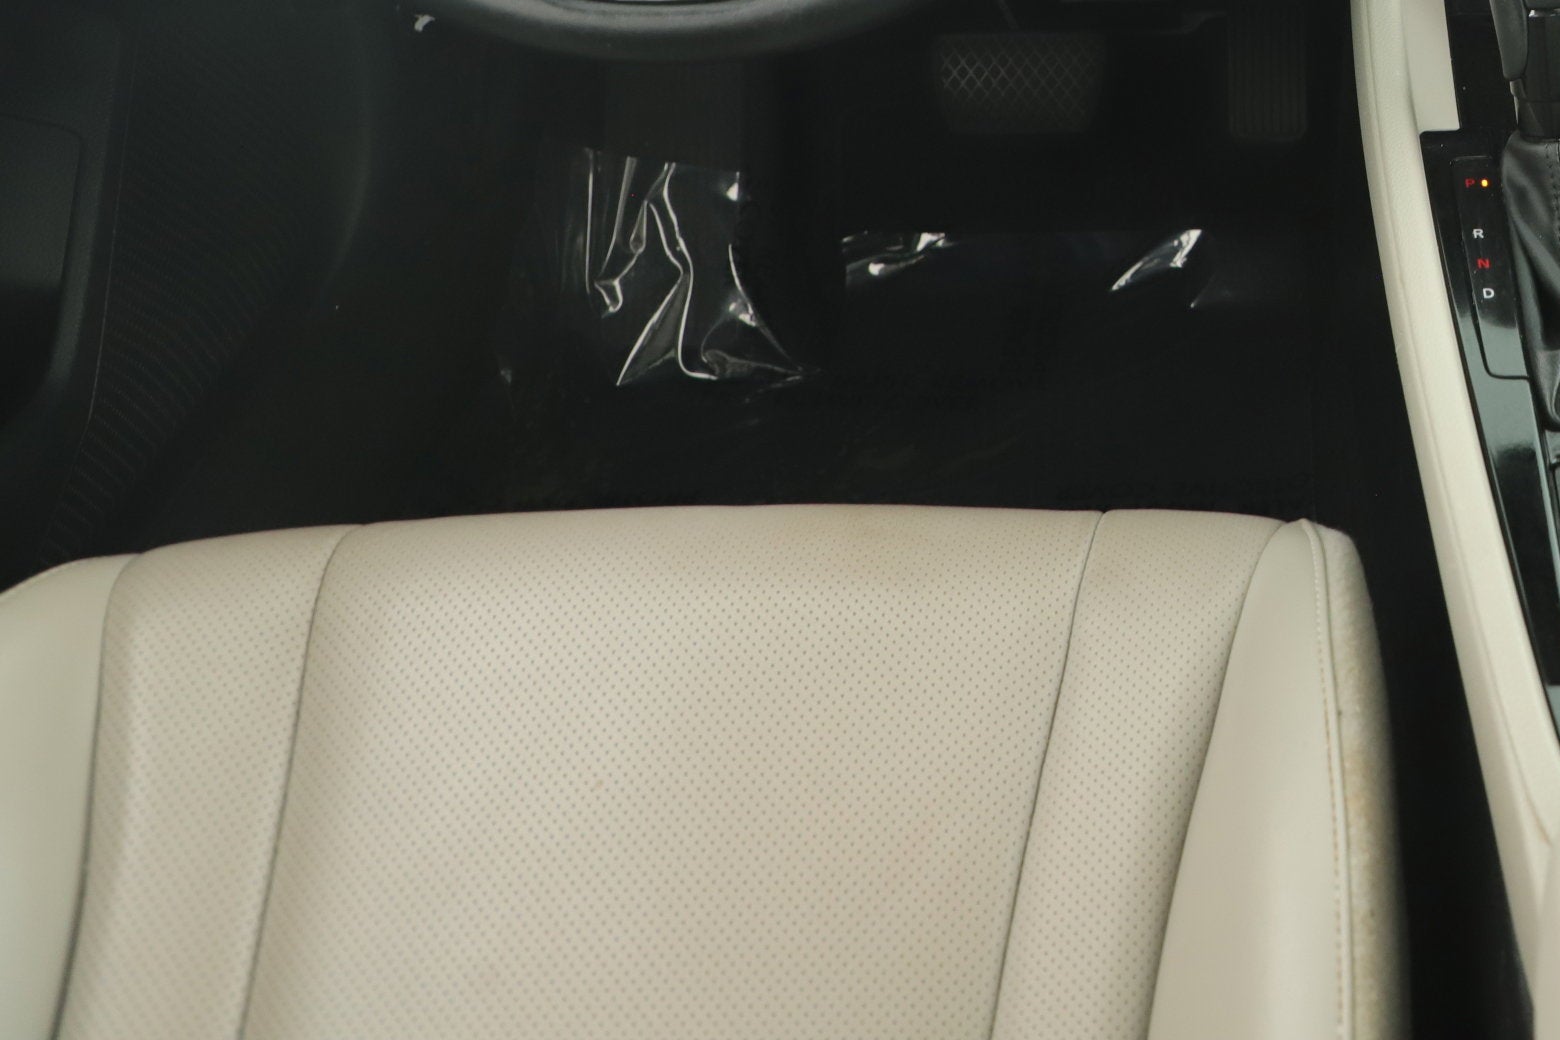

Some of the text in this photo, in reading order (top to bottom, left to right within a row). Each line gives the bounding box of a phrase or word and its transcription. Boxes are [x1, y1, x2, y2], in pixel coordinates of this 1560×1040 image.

[1464, 178, 1475, 188] P
[1472, 228, 1484, 239] R
[1477, 258, 1490, 269] N
[1482, 287, 1495, 299] D
